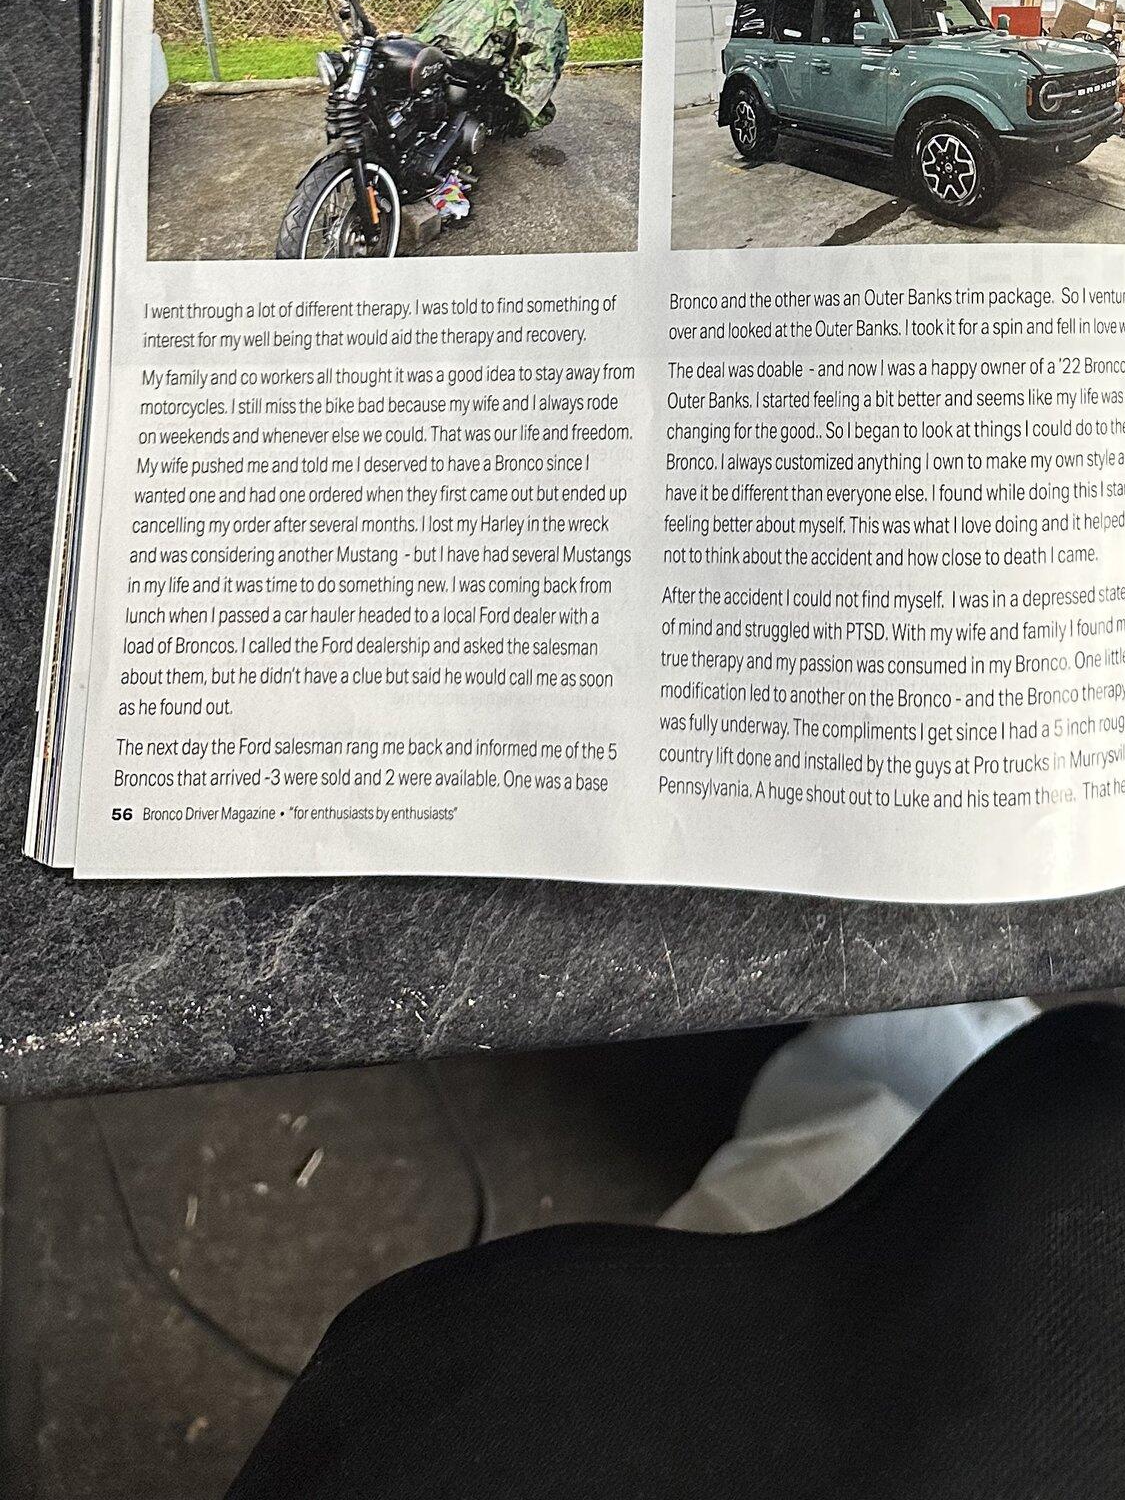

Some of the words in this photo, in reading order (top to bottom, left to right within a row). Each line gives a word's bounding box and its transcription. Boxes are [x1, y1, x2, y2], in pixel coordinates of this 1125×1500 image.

[143, 331, 195, 348] interest
[197, 330, 218, 348] for
[220, 334, 242, 351] my
[243, 330, 270, 347] well
[273, 329, 313, 351] being
[315, 329, 344, 347] that
[346, 328, 388, 346] would
[390, 328, 412, 345] aid
[414, 328, 438, 345] the
[440, 327, 495, 348] therapy
[496, 325, 523, 343] and
[526, 328, 587, 346] recovery.
[665, 452, 717, 471] Bronco.
[720, 452, 724, 470] I
[726, 452, 772, 475] always
[774, 452, 854, 471] customized
[856, 452, 921, 475] anything
[925, 452, 929, 470] I
[932, 455, 963, 470] own
[966, 453, 982, 470] to
[985, 451, 1027, 469] make
[1030, 454, 1052, 473] my
[1054, 453, 1083, 468] own
[1087, 450, 1116, 471] style
[110, 807, 133, 821] 56
[142, 806, 183, 821] Bronco
[184, 805, 219, 821] Driver
[220, 805, 276, 824] Magazine
[288, 805, 309, 820] "for
[309, 805, 374, 820] enthusiasts
[375, 806, 390, 823] by
[390, 805, 458, 821] enthusiasts"
